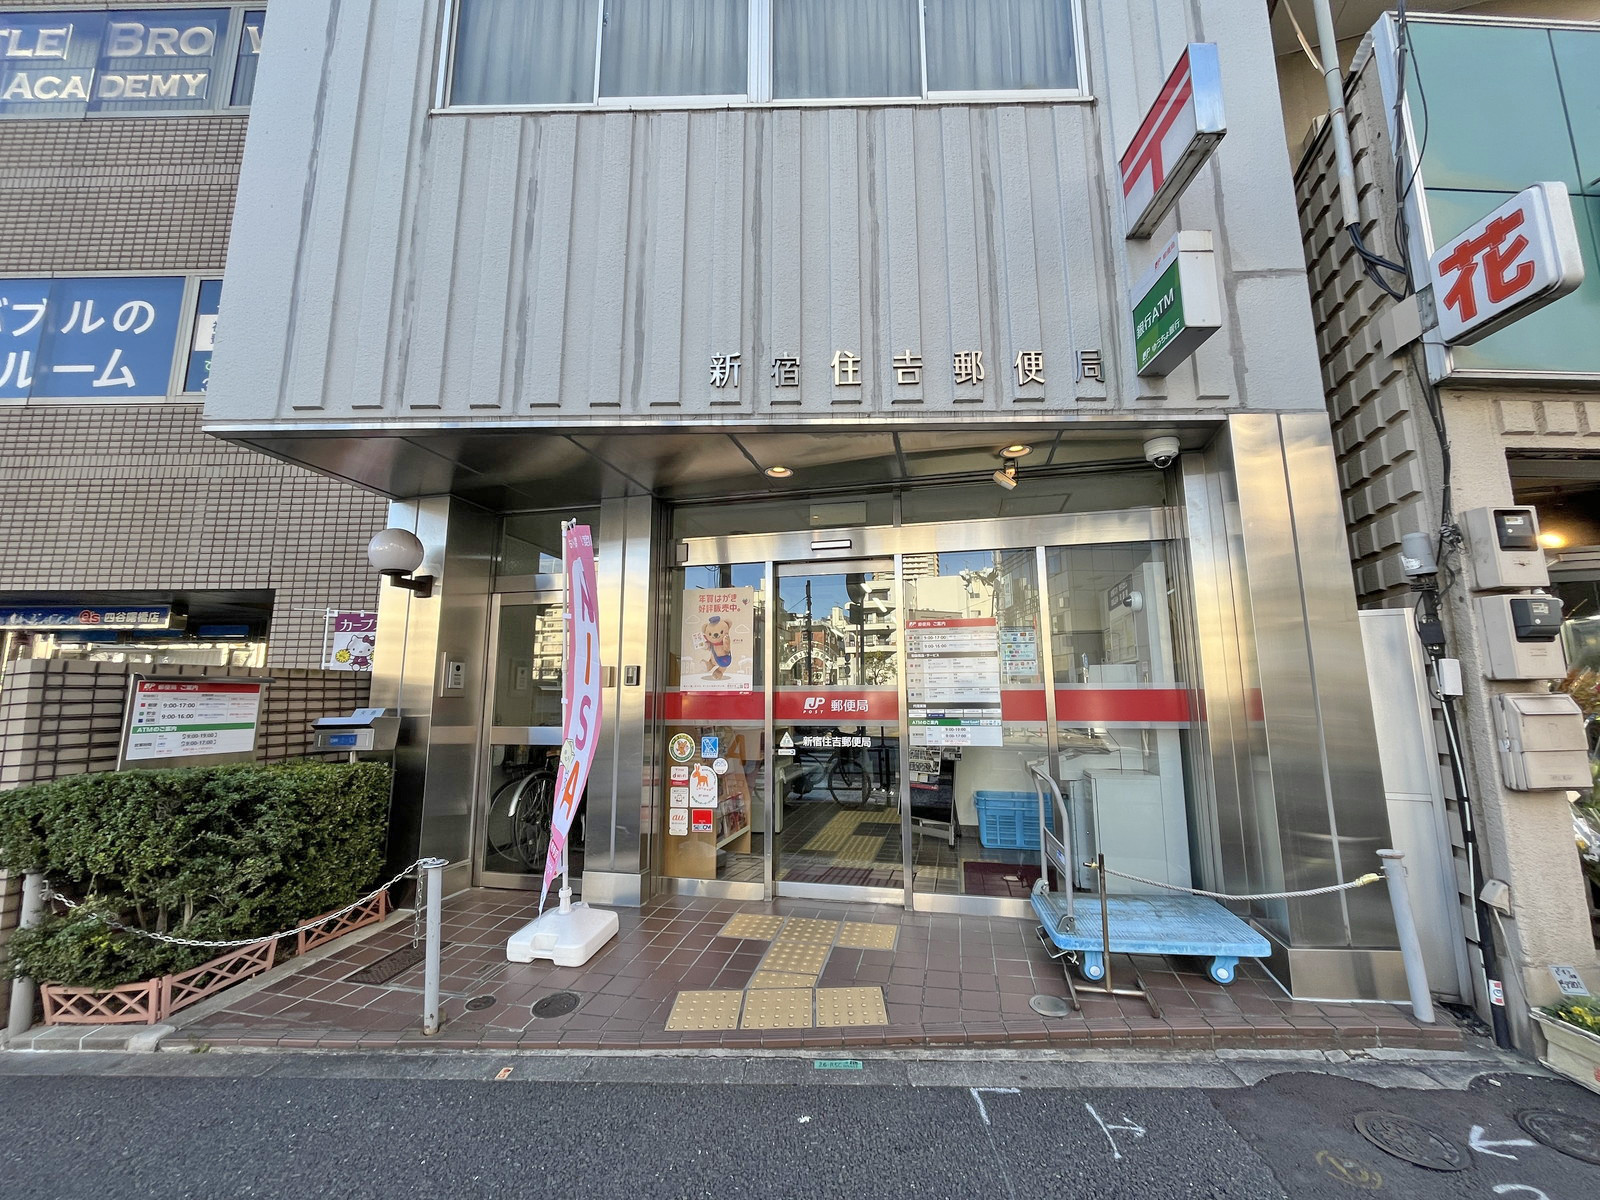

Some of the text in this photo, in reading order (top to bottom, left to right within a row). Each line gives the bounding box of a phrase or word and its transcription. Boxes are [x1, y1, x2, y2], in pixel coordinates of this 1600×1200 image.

[1438, 208, 1535, 323] 花
[1136, 287, 1174, 340] 銀行ATM
[1152, 317, 1180, 351] ゆうちょ銀行
[709, 349, 1106, 389] 新宿住吉郵便局
[698, 593, 737, 603] 年賀はがき
[803, 697, 869, 712] JP 郵便局
[802, 735, 872, 748] 新宿住吉郵便局
